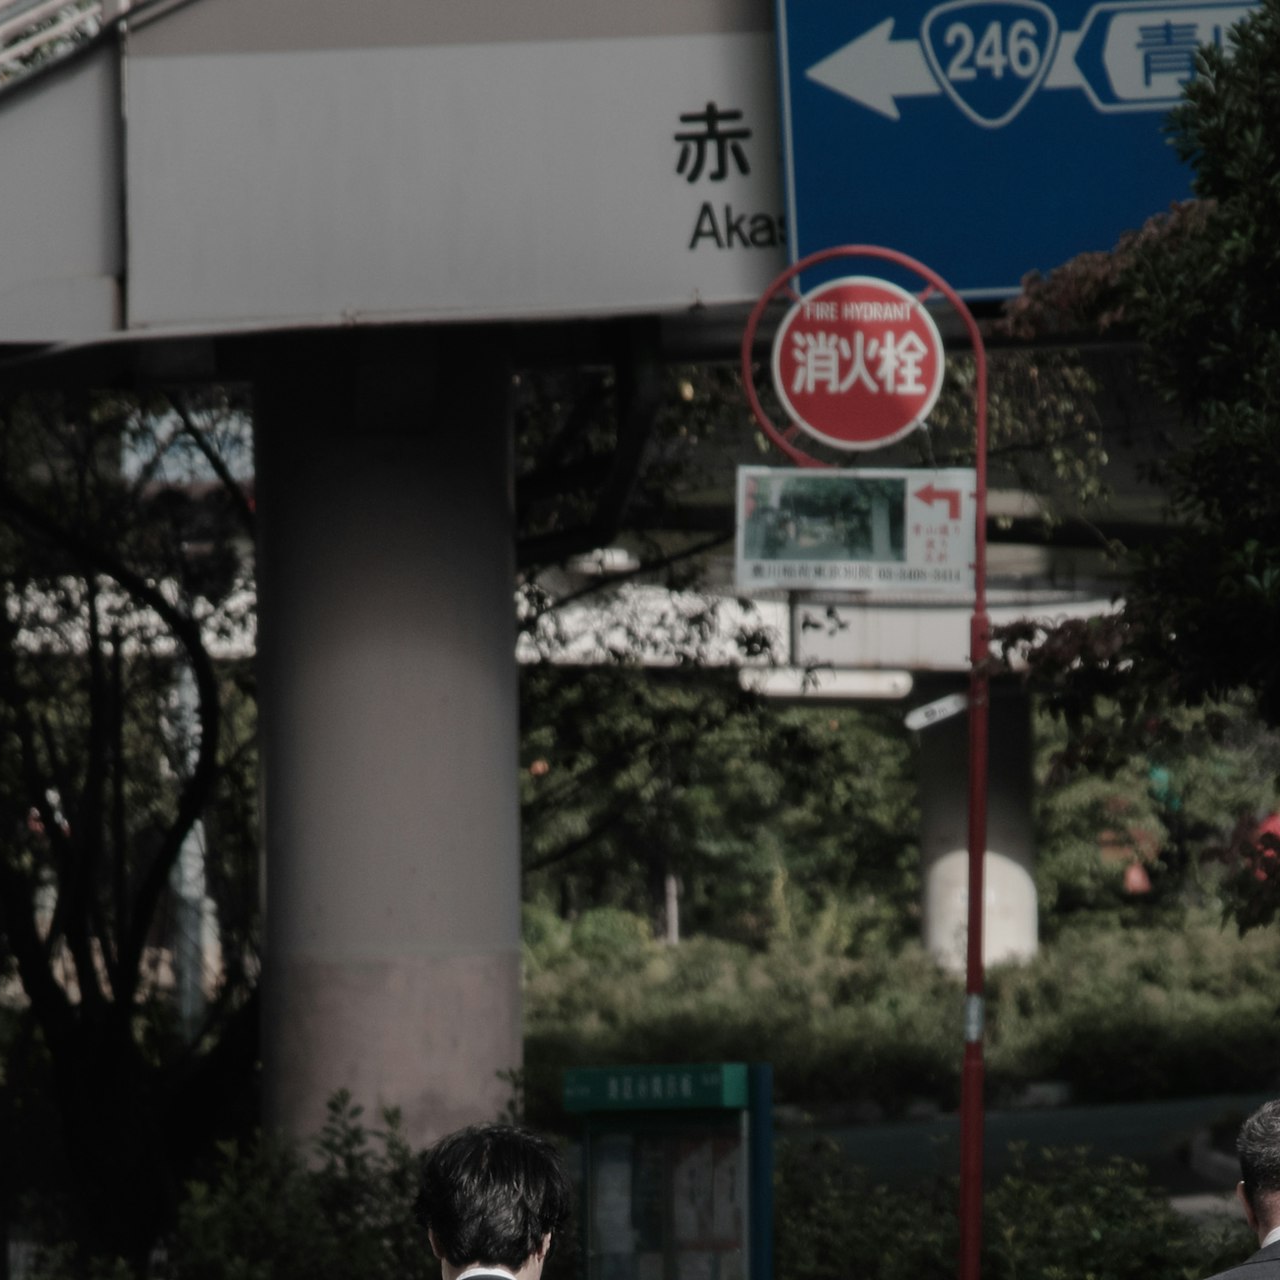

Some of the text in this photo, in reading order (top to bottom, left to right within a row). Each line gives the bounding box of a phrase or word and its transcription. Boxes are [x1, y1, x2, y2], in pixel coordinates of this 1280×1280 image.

[944, 21, 1040, 80] 246
[1137, 19, 1226, 88] 青
[673, 102, 752, 183] 赤
[804, 302, 912, 321] FIRE HYDRANT
[791, 330, 928, 395] 消火栓
